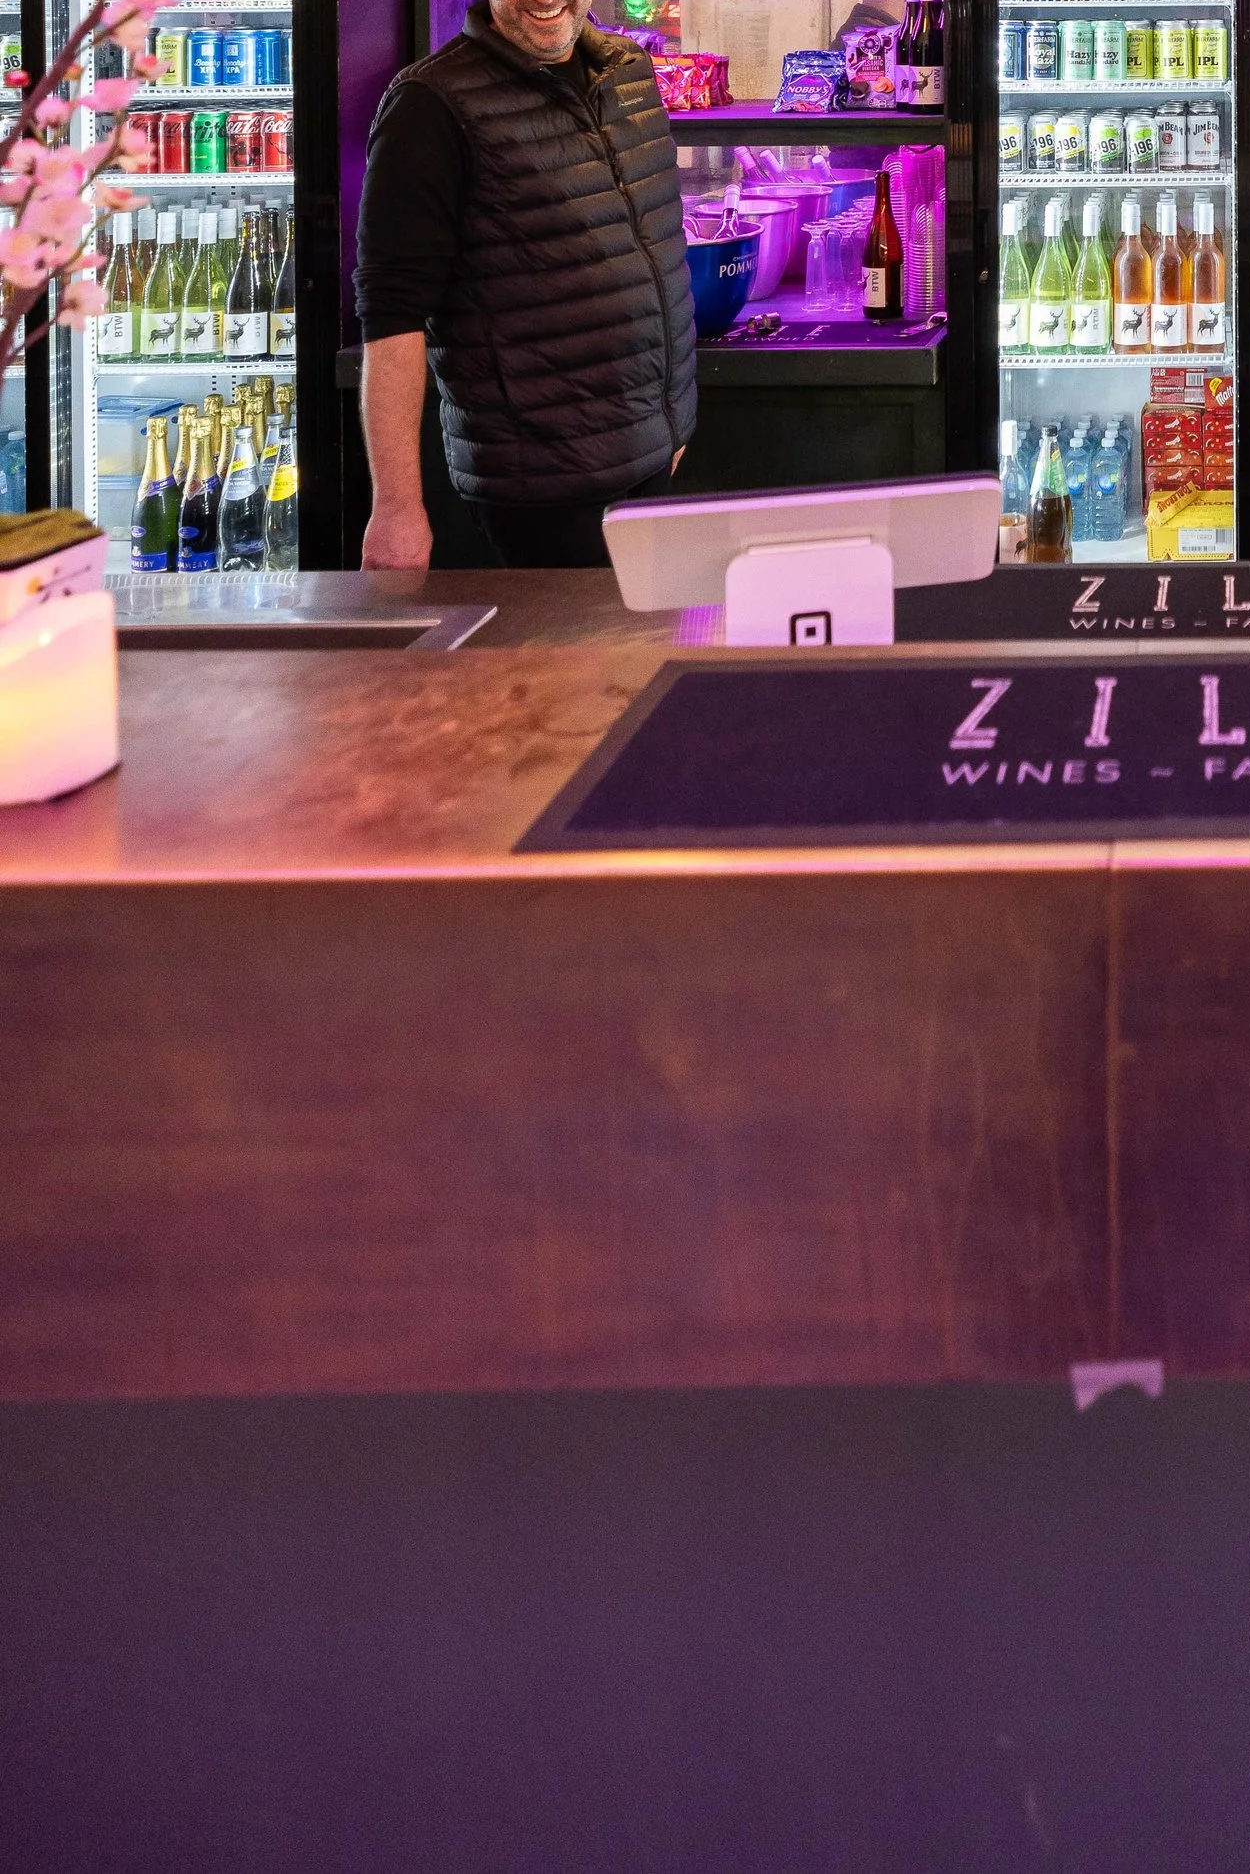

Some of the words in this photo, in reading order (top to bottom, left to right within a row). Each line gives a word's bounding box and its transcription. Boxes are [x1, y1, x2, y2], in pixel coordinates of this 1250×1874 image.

[1127, 56, 1142, 66] PL
[1163, 56, 1185, 66] IPL
[1197, 56, 1219, 65] IPL
[787, 84, 829, 95] NOBBY'S
[1193, 123, 1206, 136] JIM
[114, 316, 124, 338] BTW
[212, 313, 221, 336] BTW
[1156, 485, 1193, 514] TOBLERONE
[1070, 616, 1176, 630] WINES
[941, 758, 1120, 787] WINES
